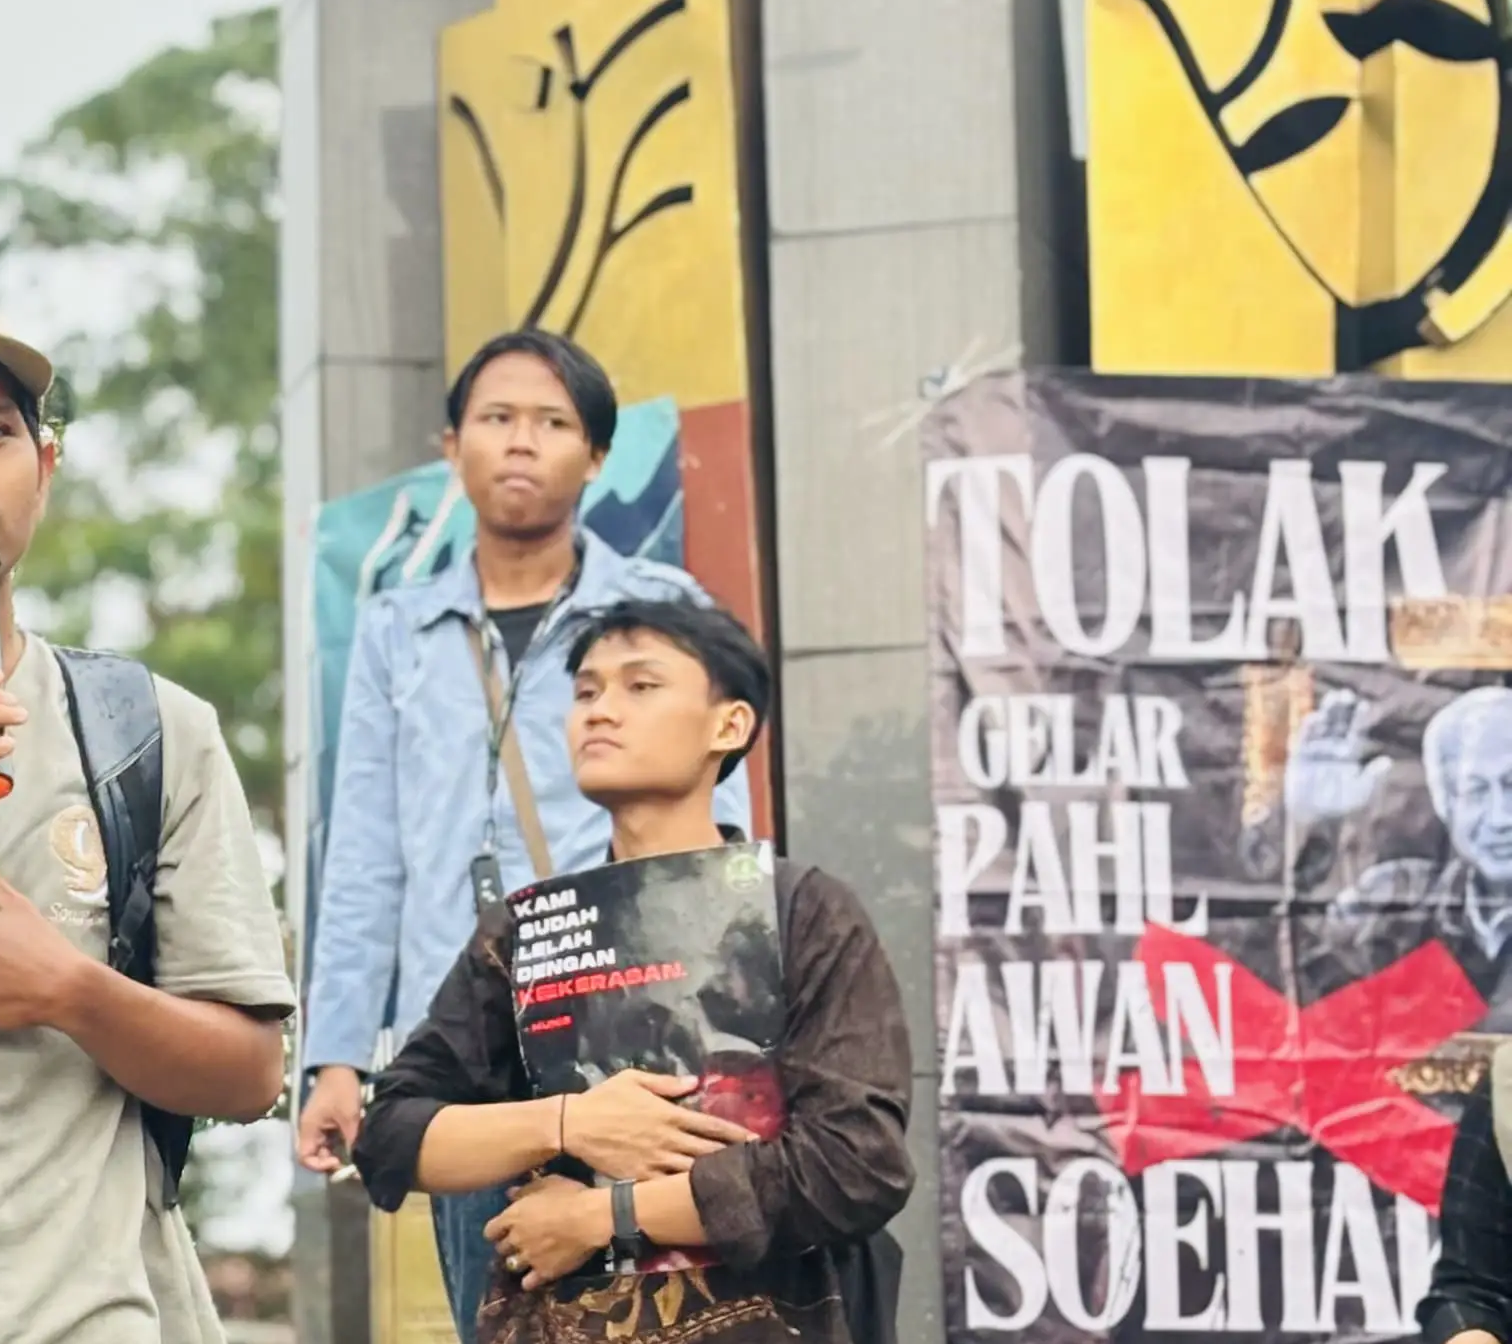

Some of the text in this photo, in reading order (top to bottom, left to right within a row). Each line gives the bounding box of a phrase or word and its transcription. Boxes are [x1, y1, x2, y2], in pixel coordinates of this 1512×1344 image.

[926, 453, 1448, 663] TOLAK
[958, 694, 1190, 790] GELAR
[937, 801, 1209, 937] PAHL
[514, 888, 577, 918] KAMI
[519, 906, 598, 940] SUDAH
[516, 948, 616, 983] DENGAN
[519, 929, 593, 961] LELAH
[941, 961, 1236, 1096] AWAN
